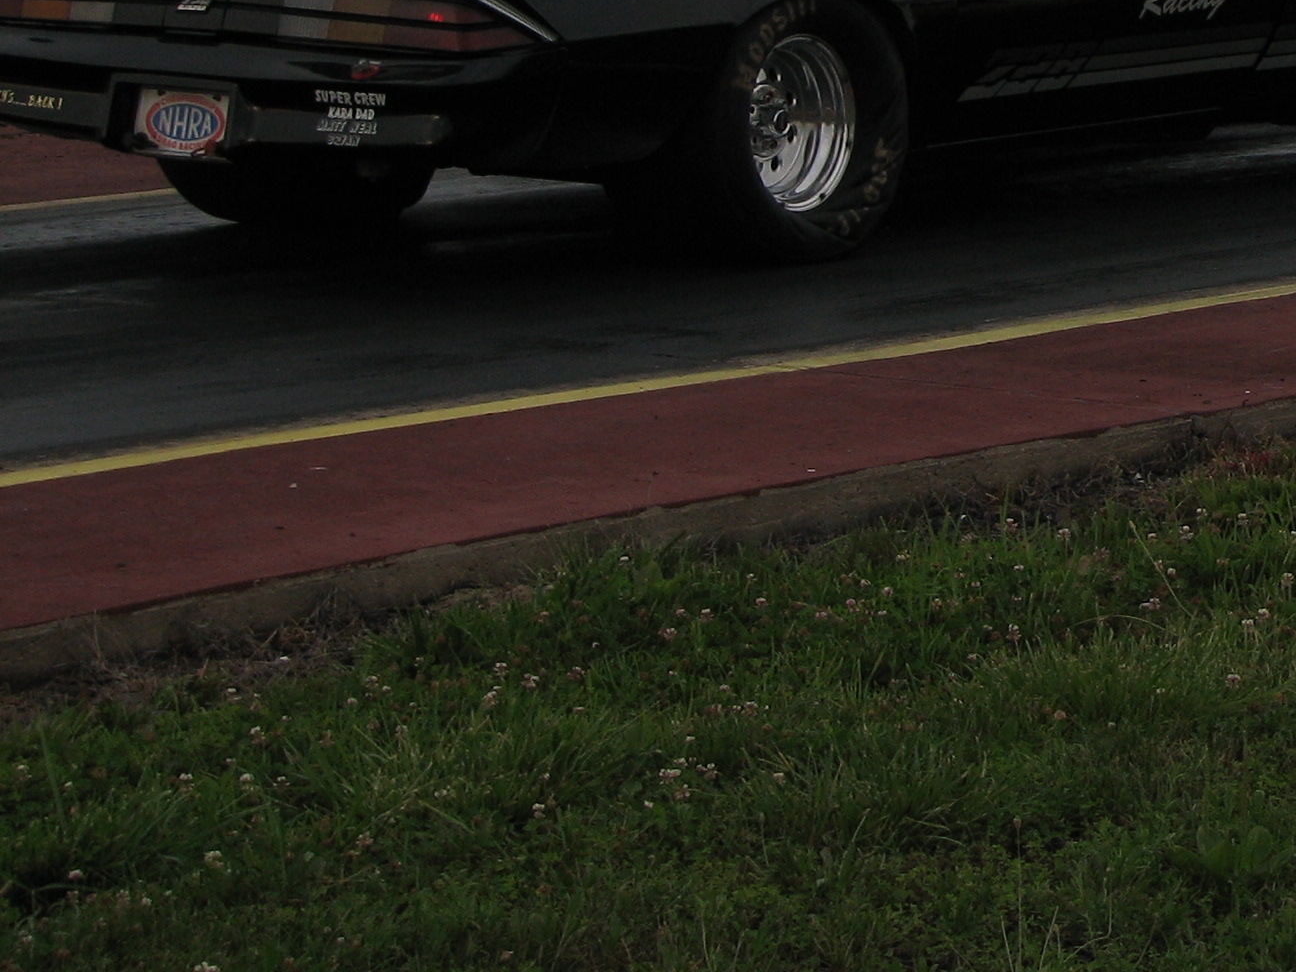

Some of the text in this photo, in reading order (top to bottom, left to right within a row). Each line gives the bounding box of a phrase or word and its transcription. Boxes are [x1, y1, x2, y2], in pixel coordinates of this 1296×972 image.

[314, 89, 387, 106] SUPER CREW
[159, 106, 212, 139] NHRA
